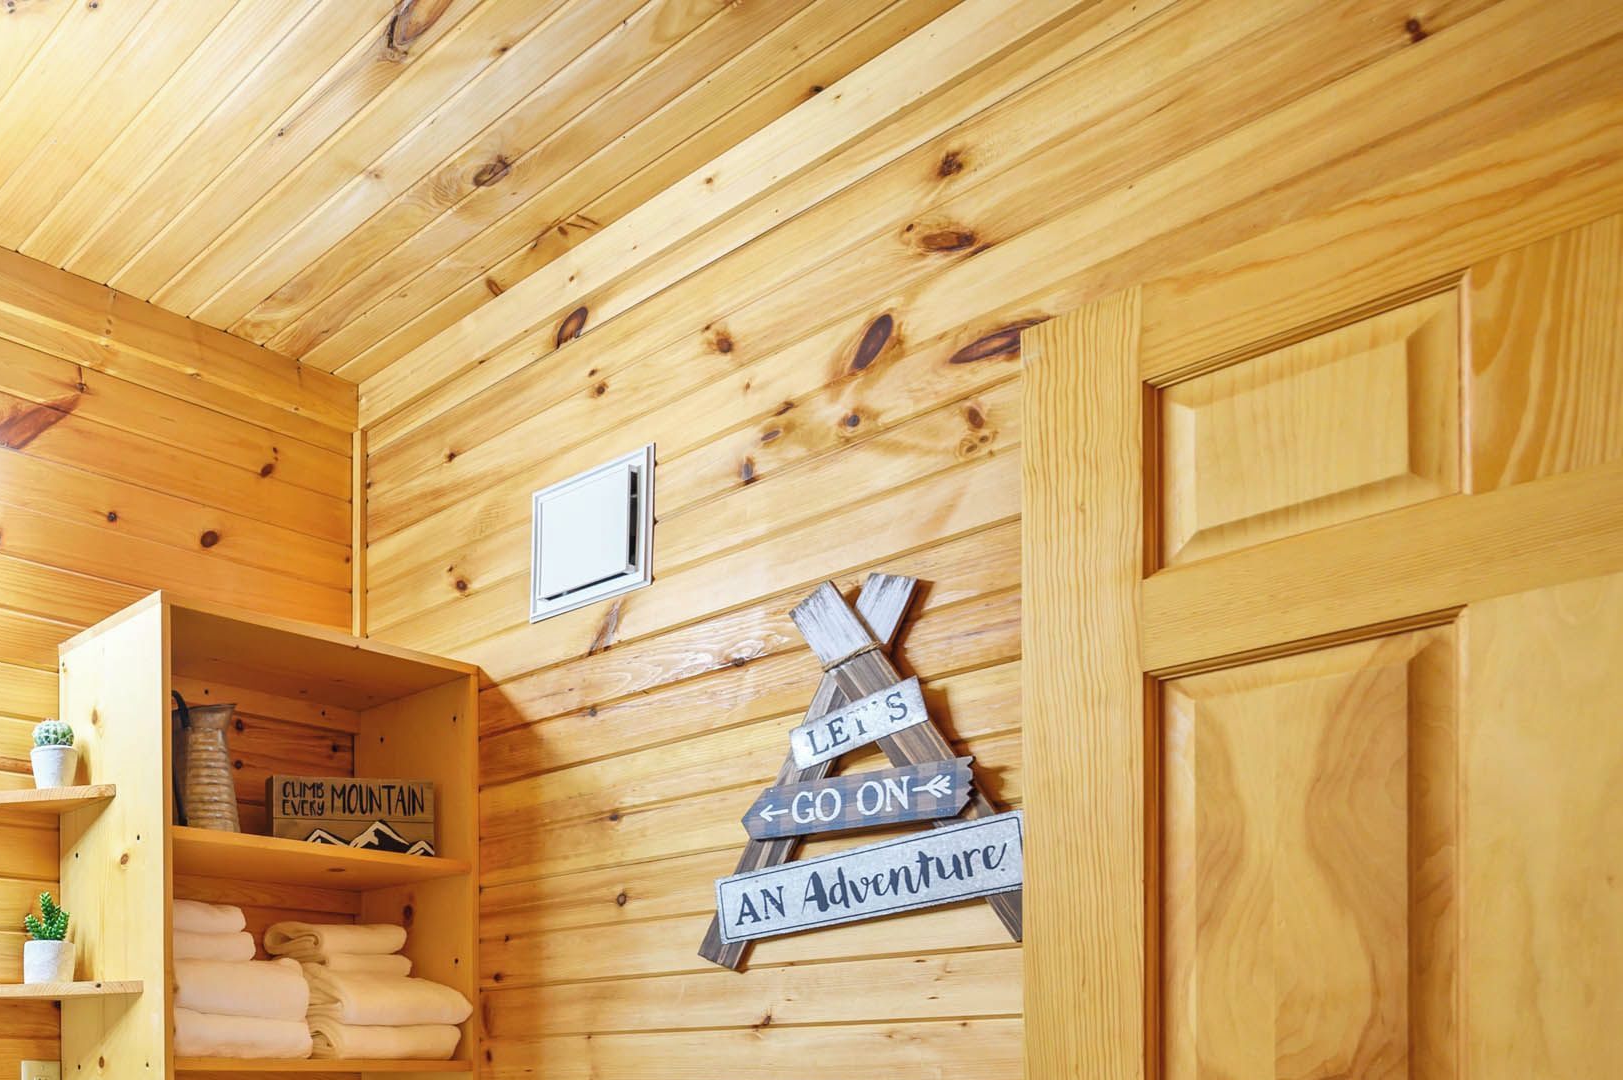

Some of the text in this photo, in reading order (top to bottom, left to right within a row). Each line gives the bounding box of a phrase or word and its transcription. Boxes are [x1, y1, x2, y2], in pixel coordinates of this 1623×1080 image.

[282, 781, 325, 799] CLIMB
[330, 783, 425, 817] MOUNTAIN
[792, 774, 914, 824] GO ON
[282, 800, 325, 816] EVERY
[735, 842, 1008, 926] AN Adventure
